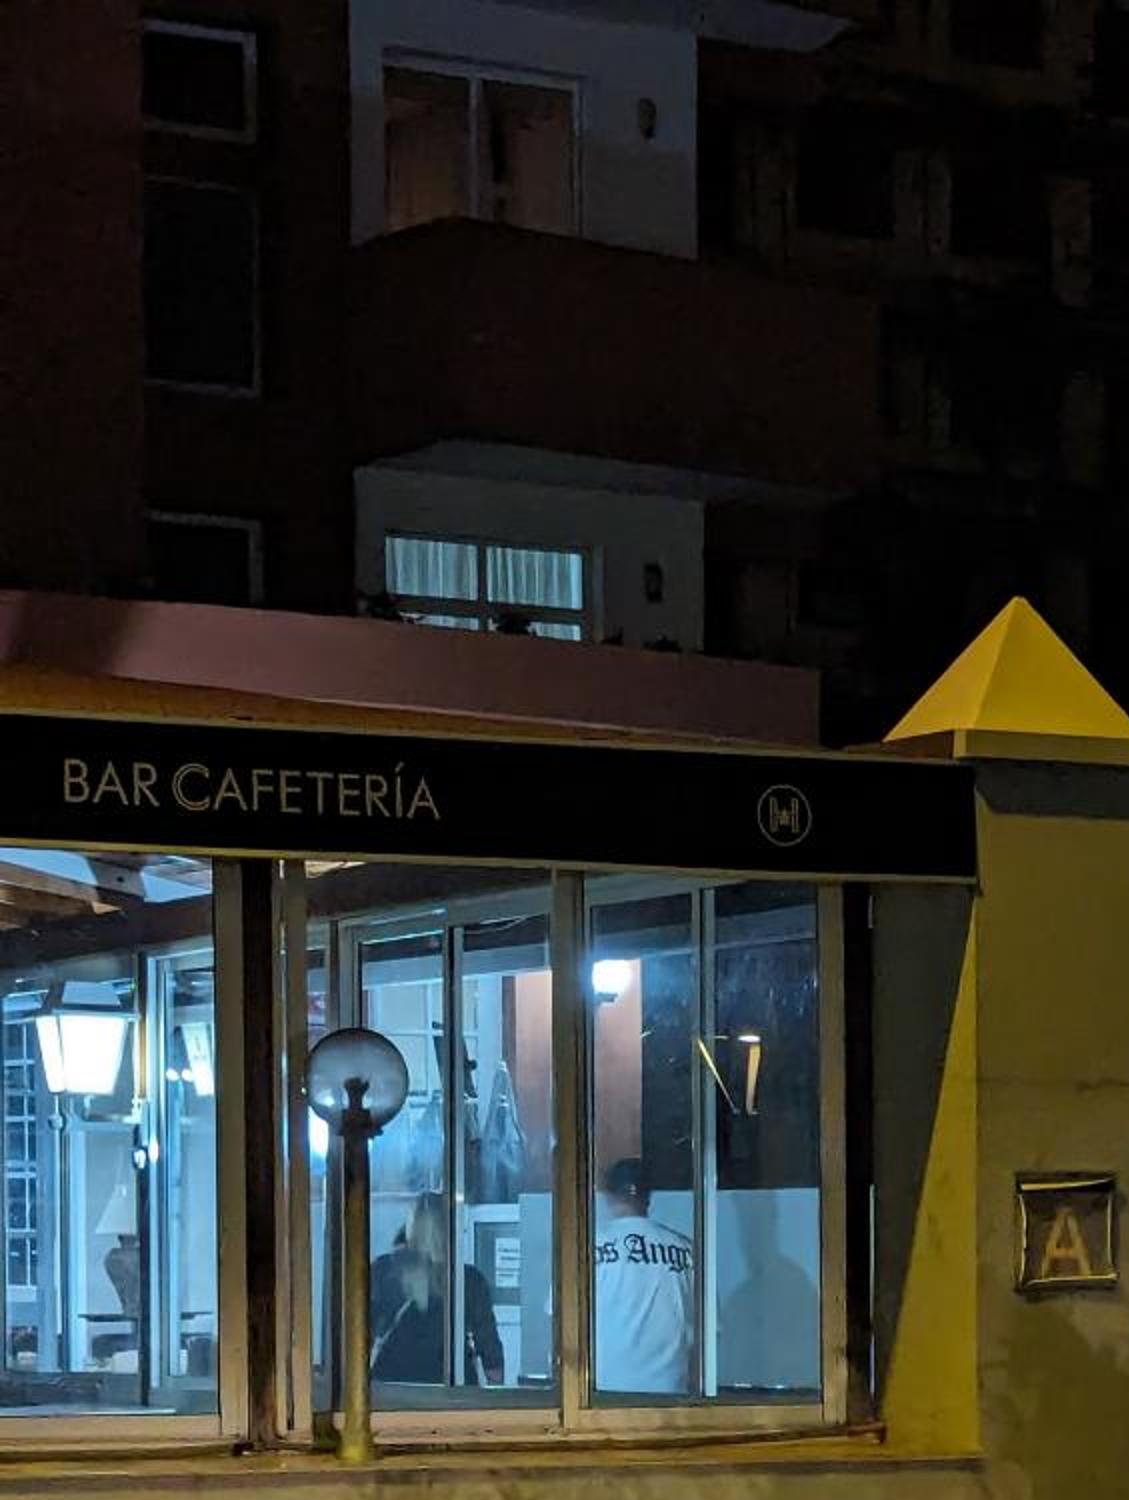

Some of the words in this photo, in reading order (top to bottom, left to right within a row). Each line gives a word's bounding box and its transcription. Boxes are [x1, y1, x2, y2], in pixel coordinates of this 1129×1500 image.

[63, 757, 158, 807] BAR
[172, 762, 441, 820] CAFETERÍA
[1041, 1207, 1092, 1279] A
